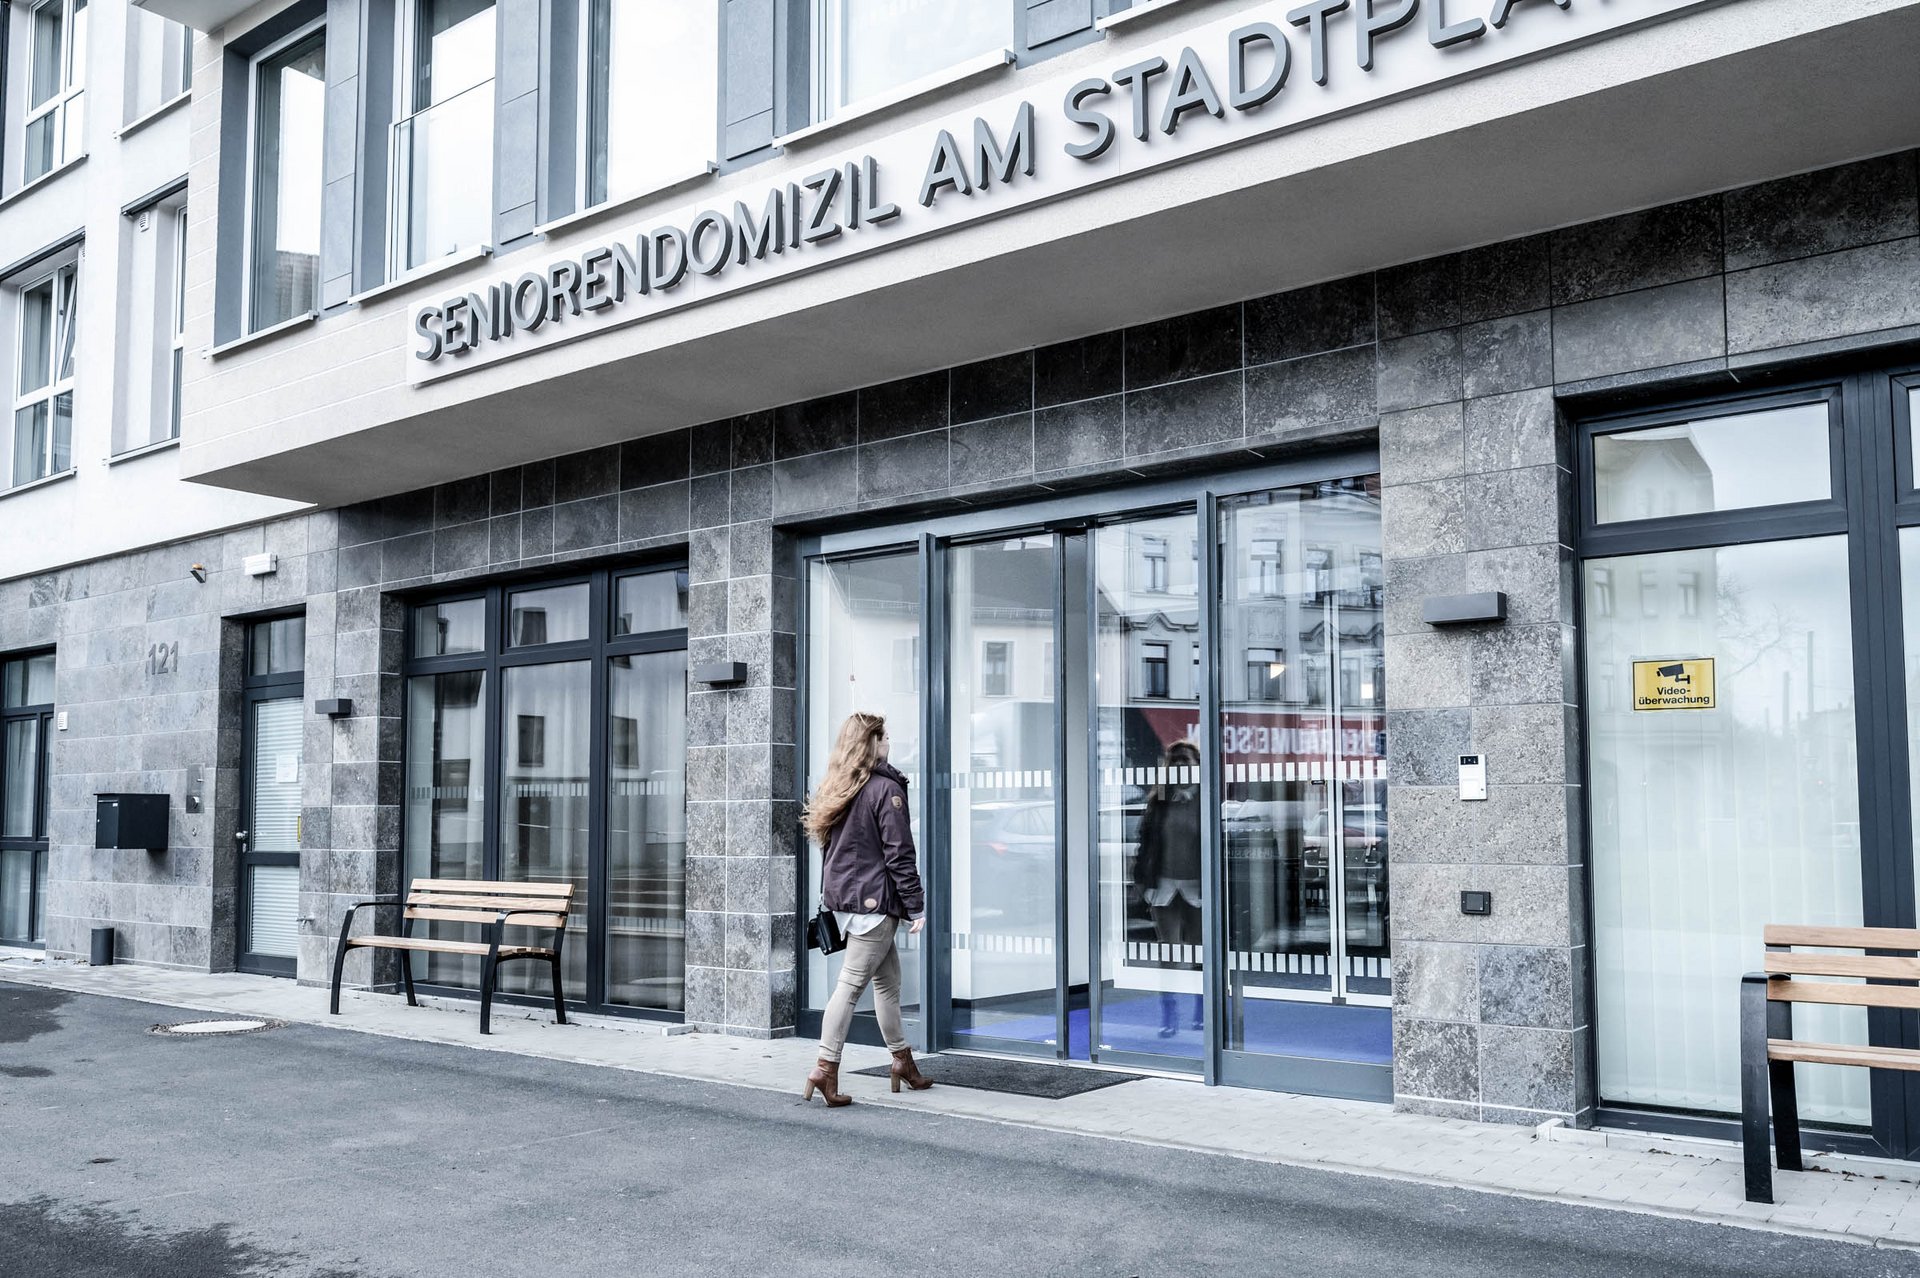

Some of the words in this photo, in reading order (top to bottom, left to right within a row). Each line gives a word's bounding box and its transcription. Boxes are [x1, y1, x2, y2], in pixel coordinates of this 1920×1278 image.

[415, 155, 902, 361] SENIORENDOMIZIL
[918, 100, 1035, 207] AM
[148, 640, 179, 675] 121
[1638, 696, 1710, 705] überwachung
[1656, 686, 1691, 695] Video-
